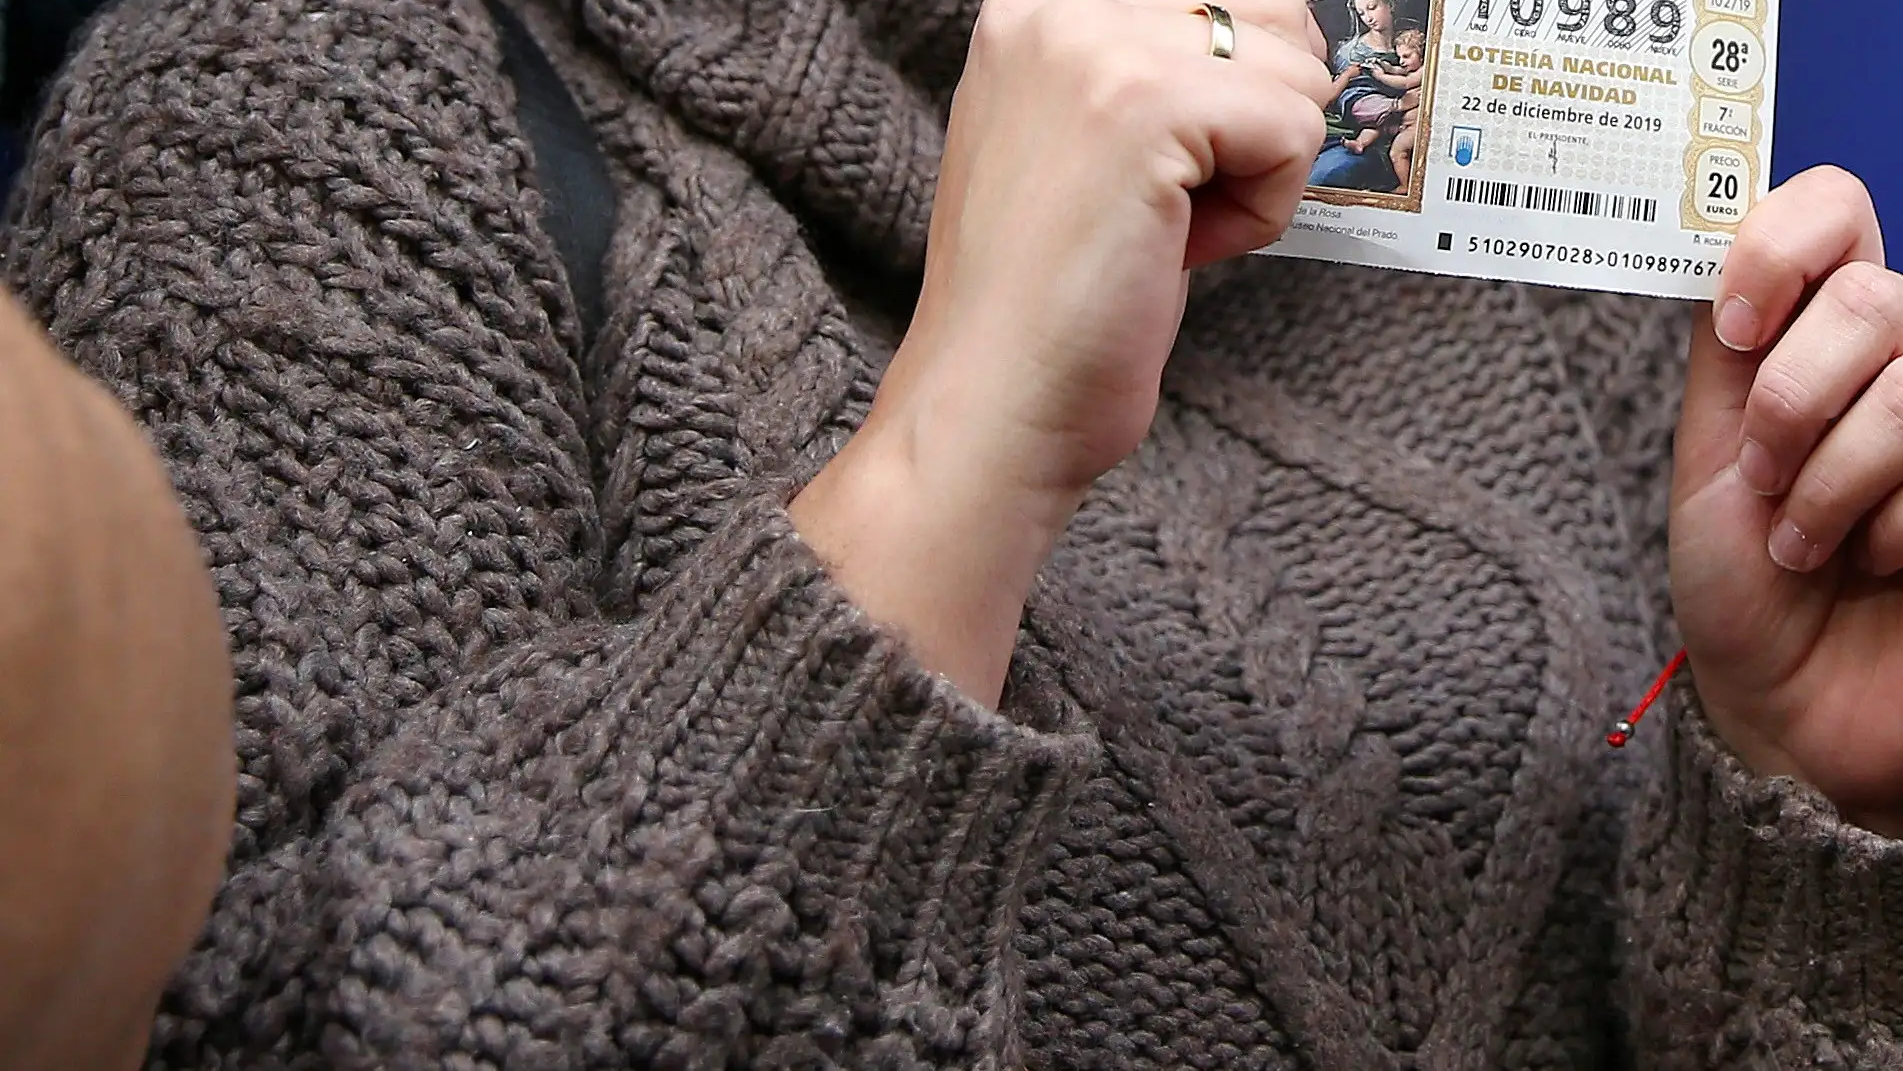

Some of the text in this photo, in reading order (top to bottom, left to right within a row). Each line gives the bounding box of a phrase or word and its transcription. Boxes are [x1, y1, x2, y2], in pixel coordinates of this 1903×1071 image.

[1557, 32, 1587, 44] NUEVE
[1452, 43, 1678, 86] LOTERÍA NACIONAL
[1491, 73, 1638, 106] DE NAVIDAD
[1716, 76, 1739, 89] SERIE
[1461, 95, 1663, 133] 22 de diciembre de 2019
[1528, 130, 1538, 140] EL
[1702, 121, 1748, 138] FRACCIÓN
[1709, 153, 1741, 168] PRECIO
[1707, 171, 1739, 201] 20
[1309, 207, 1318, 216] la
[1319, 208, 1343, 219] Rosa
[1706, 204, 1740, 217] EUROS
[1290, 220, 1315, 231] useo
[1316, 222, 1355, 235] Nacional
[1356, 226, 1371, 237] del
